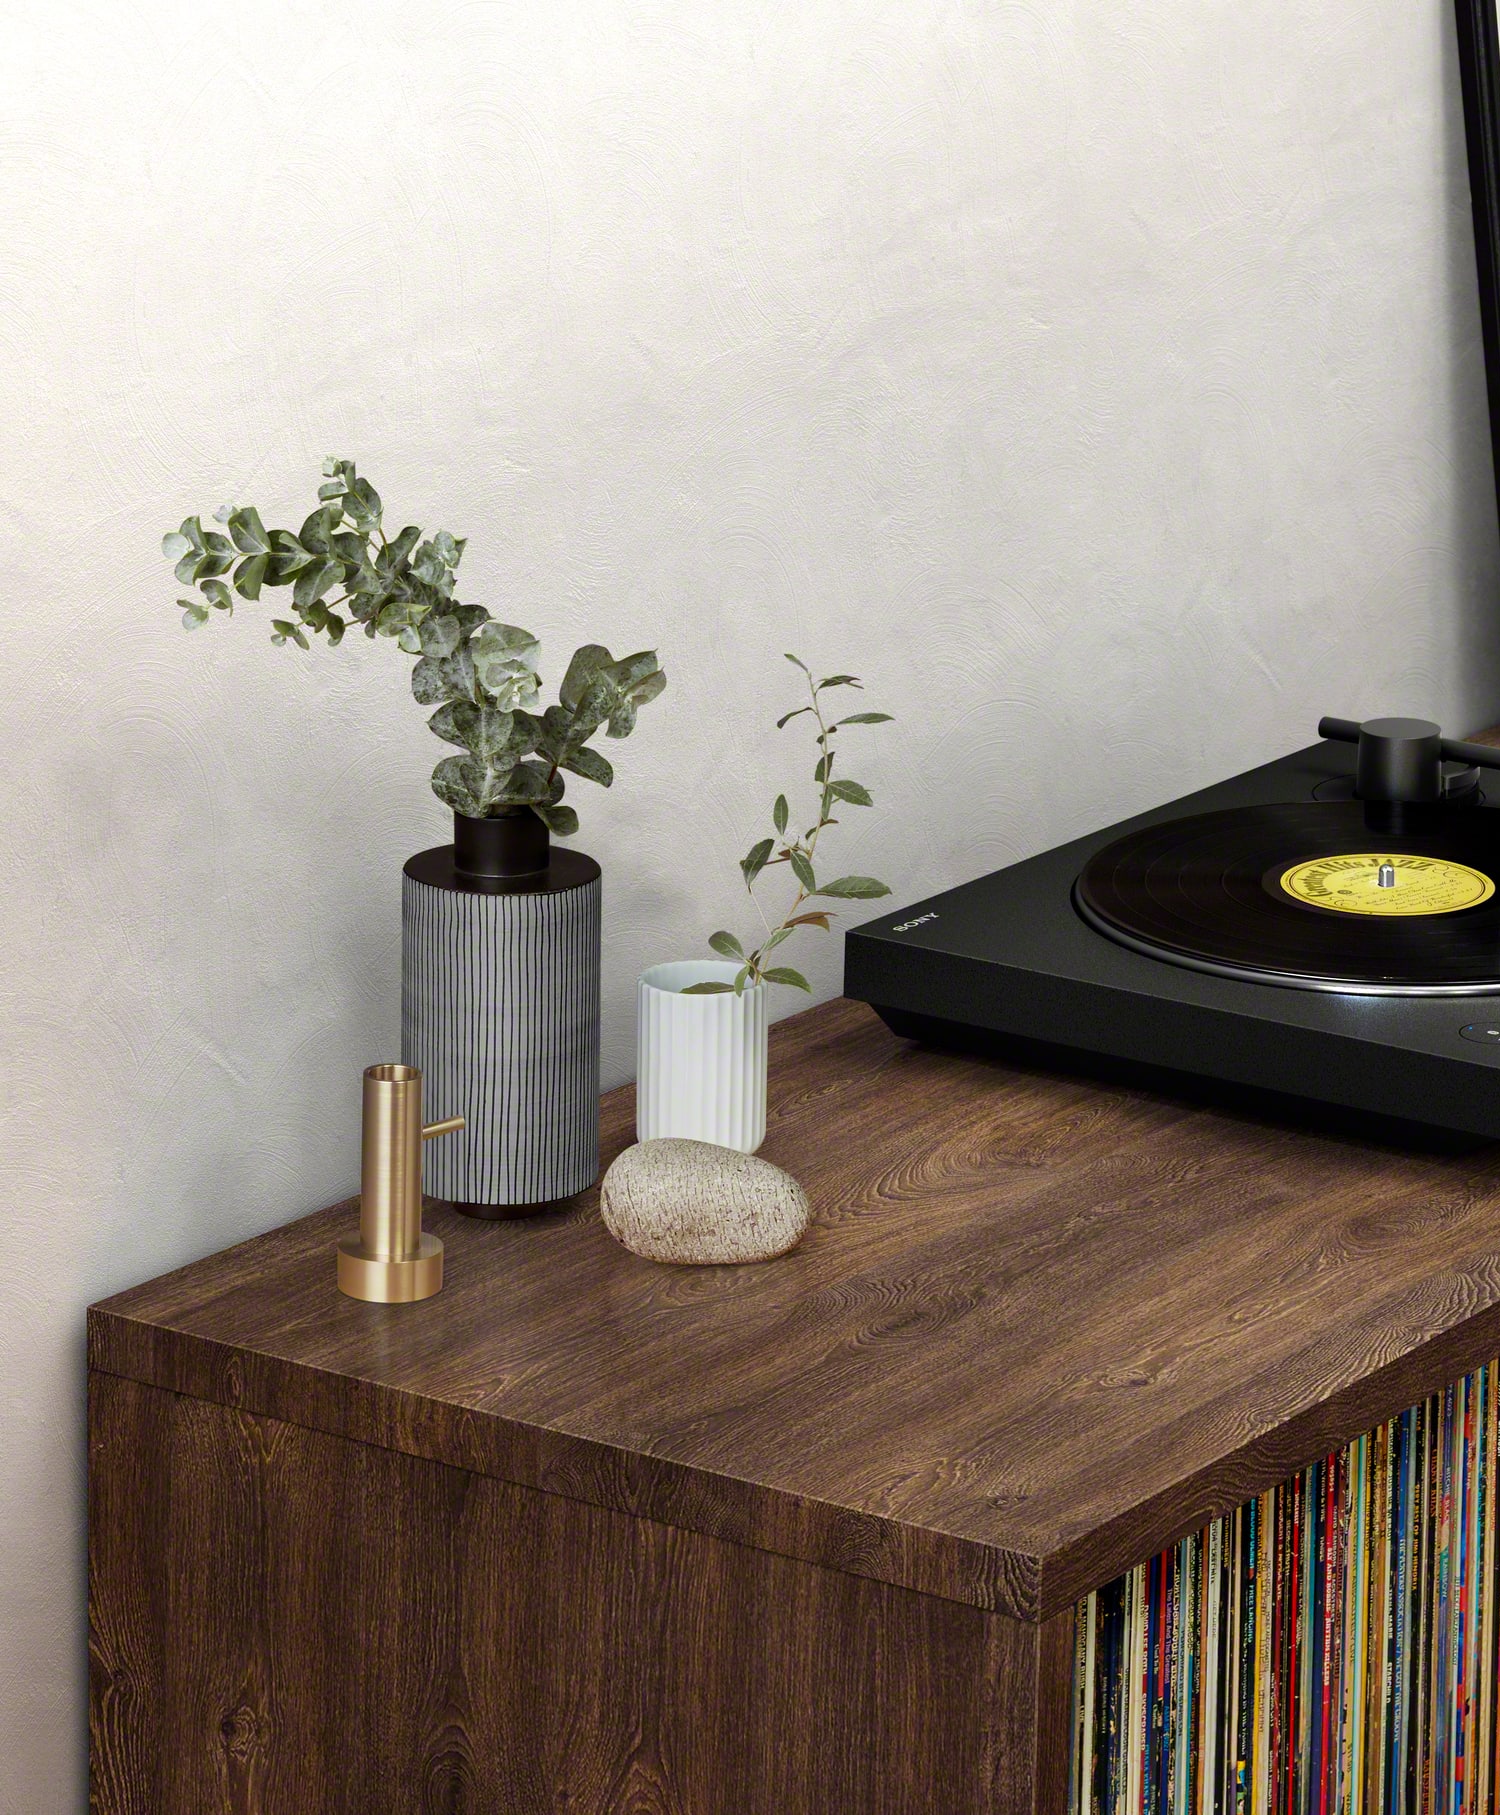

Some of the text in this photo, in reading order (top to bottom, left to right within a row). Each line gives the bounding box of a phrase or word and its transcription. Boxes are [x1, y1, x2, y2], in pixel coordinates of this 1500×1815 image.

[1318, 860, 1366, 874] Hits
[1367, 858, 1436, 872] JAZZ
[892, 912, 940, 933] SONY
